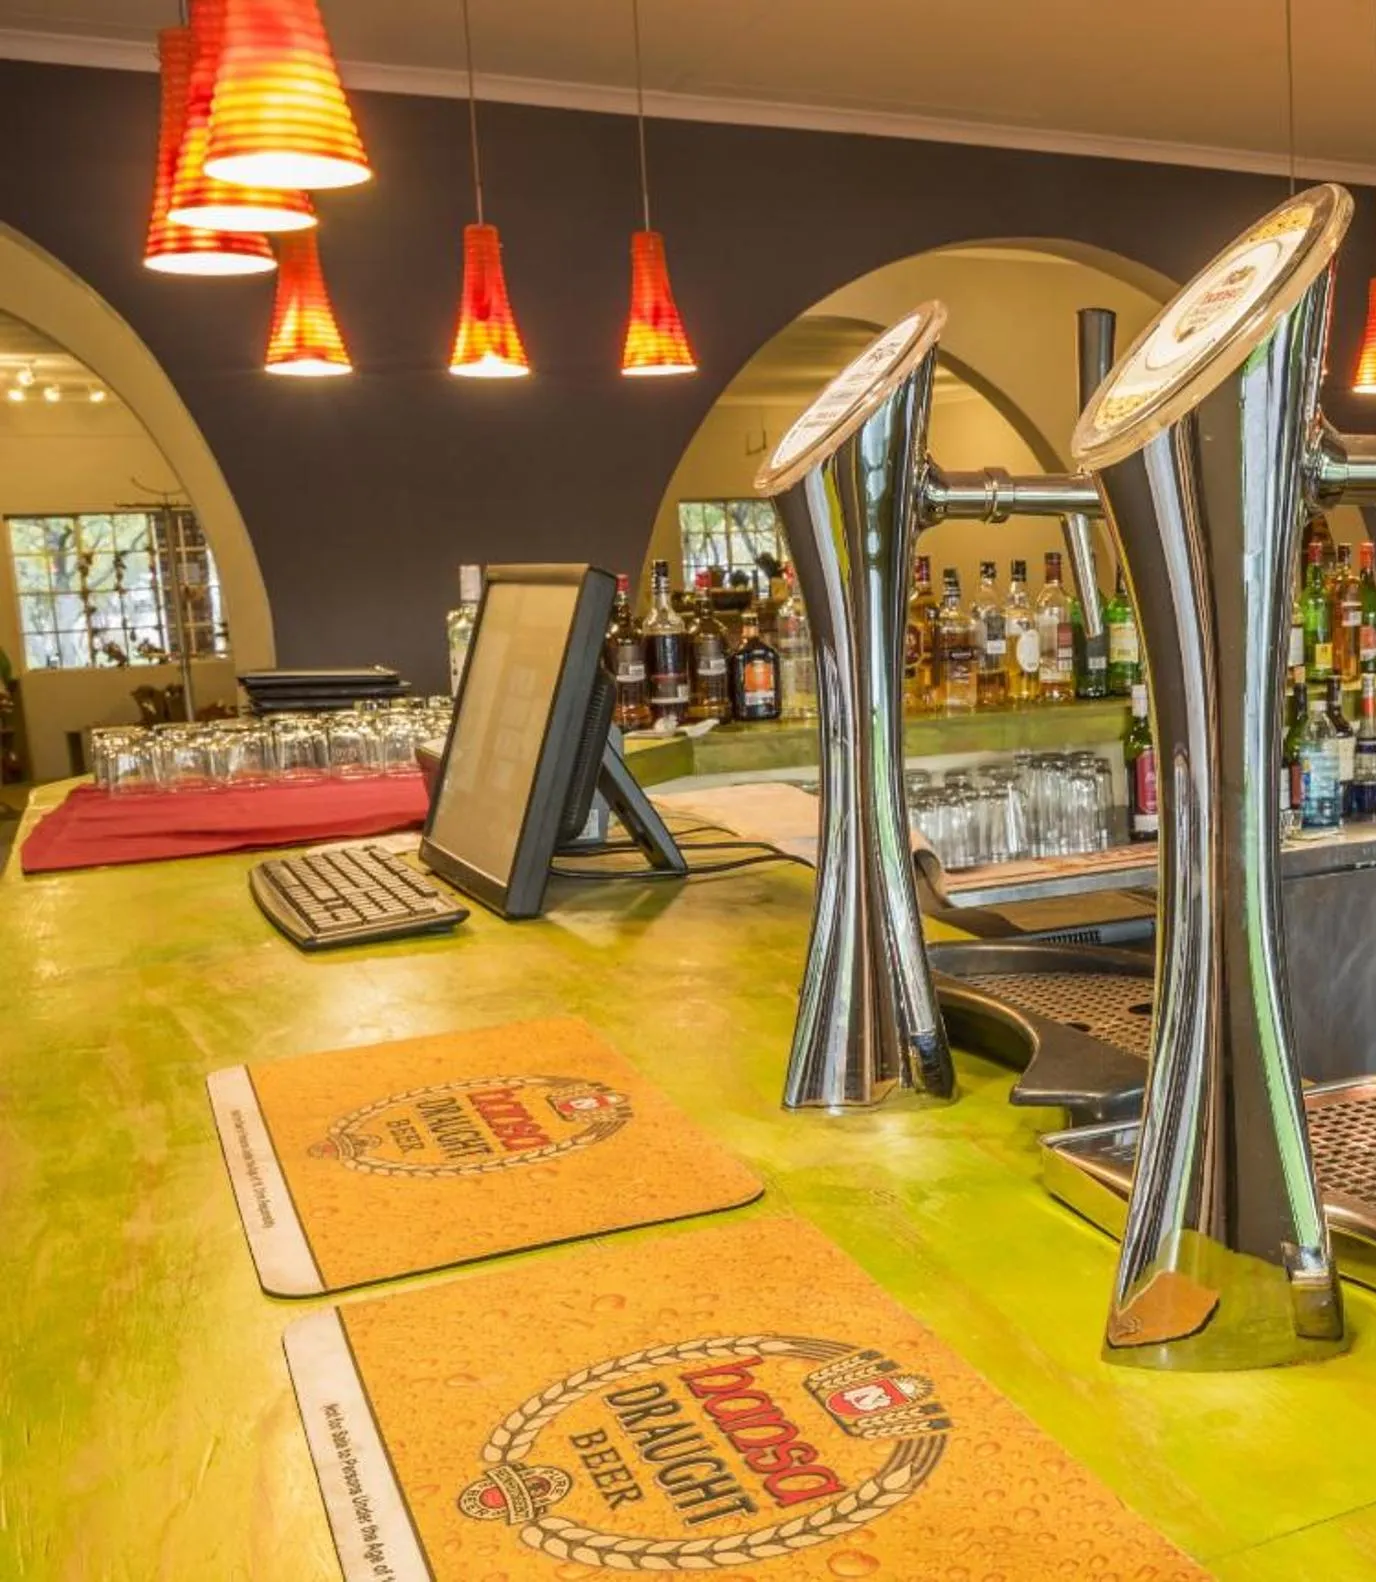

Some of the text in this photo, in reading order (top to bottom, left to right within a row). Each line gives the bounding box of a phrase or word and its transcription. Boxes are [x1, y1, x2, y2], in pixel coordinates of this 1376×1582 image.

[386, 1118, 425, 1154] BEER
[416, 1097, 494, 1159] DRAUGHT
[679, 1355, 847, 1508] hansa
[569, 1427, 644, 1511] BEER
[606, 1380, 761, 1526] DRAUGHT
[340, 1458, 362, 1496] Persons
[352, 1495, 374, 1524] Under
[361, 1525, 379, 1542] the
[364, 1543, 384, 1564] Age
[373, 1565, 394, 1576] of
